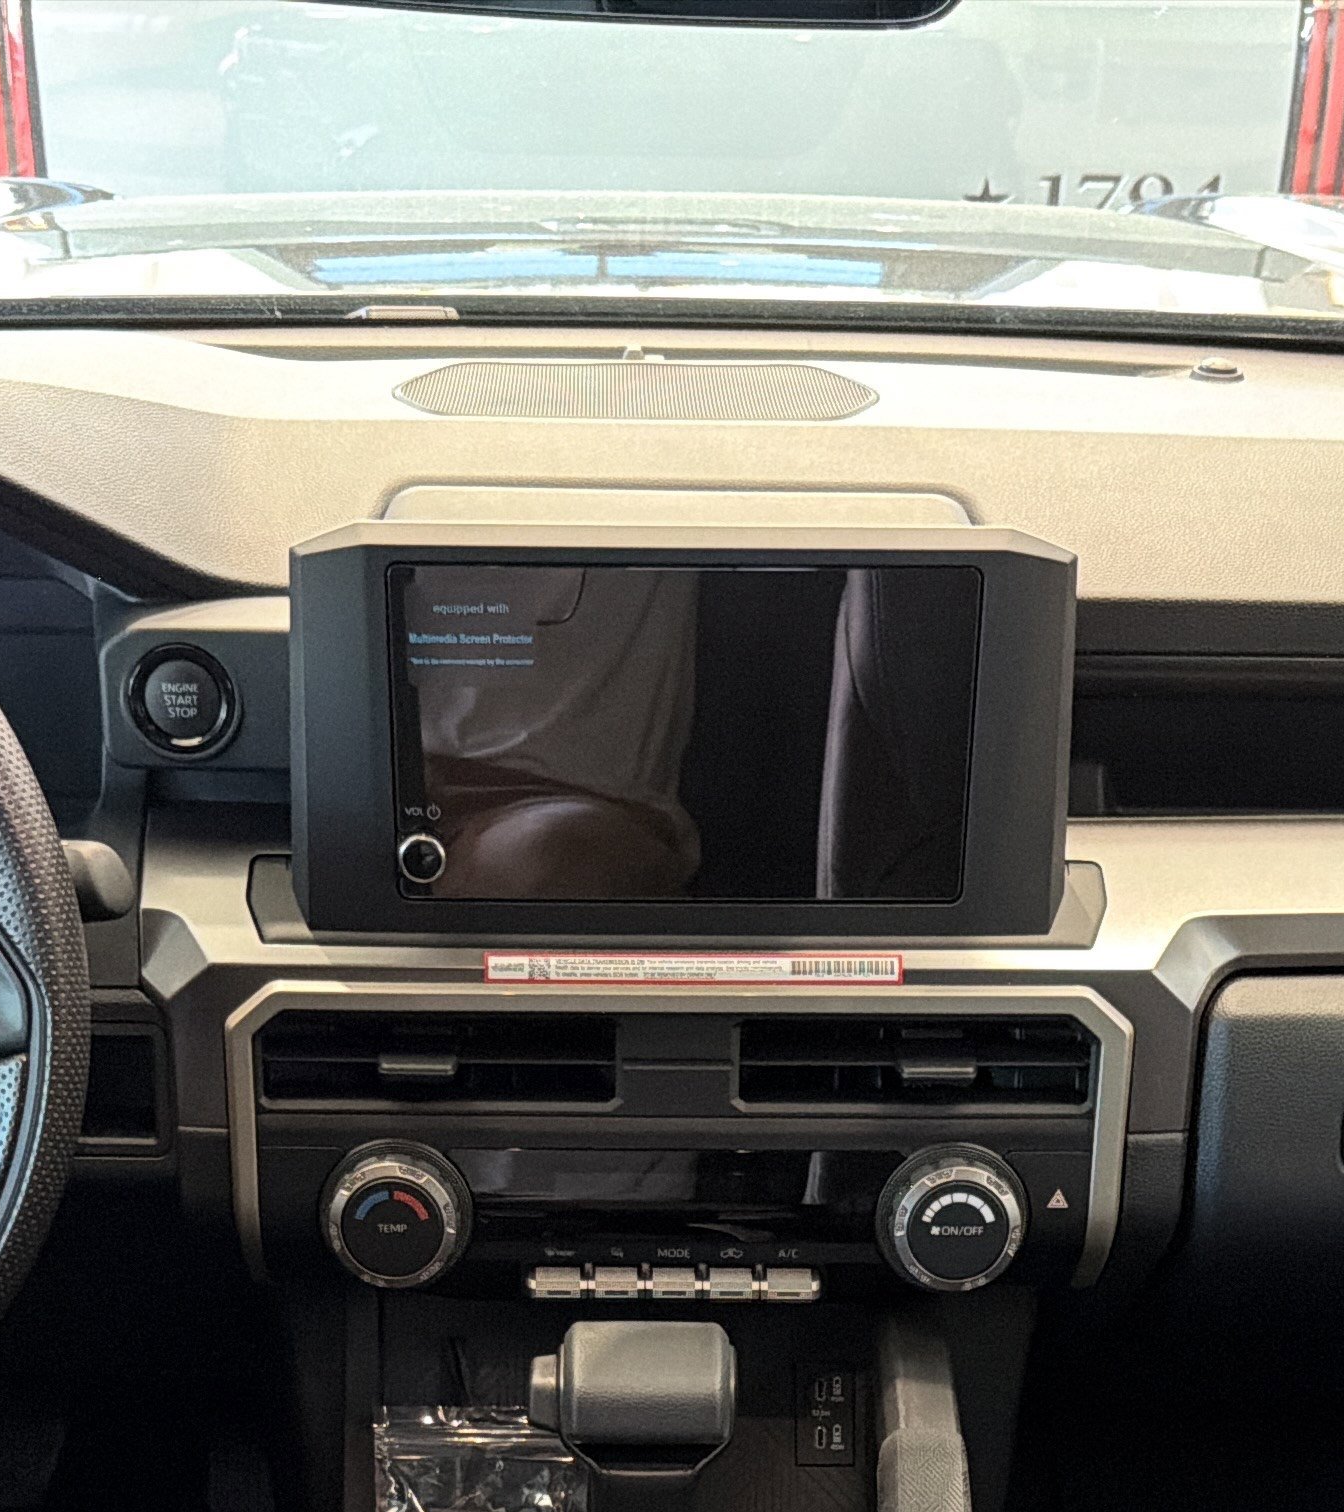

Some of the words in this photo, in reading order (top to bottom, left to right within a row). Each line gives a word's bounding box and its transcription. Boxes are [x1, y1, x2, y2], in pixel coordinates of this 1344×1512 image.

[432, 603, 484, 616] equipped
[487, 603, 509, 614] with
[408, 633, 457, 644] Multimedia
[459, 633, 491, 644] Screen
[492, 633, 534, 644] Protector
[161, 682, 199, 693] ENGINE
[163, 694, 198, 706] START
[168, 706, 198, 718] STOP
[404, 807, 424, 816] VOL
[377, 1223, 408, 1234] TEMP
[941, 1225, 984, 1236] ON/OFF
[657, 1249, 691, 1258] MODE
[778, 1249, 799, 1259] A/C
